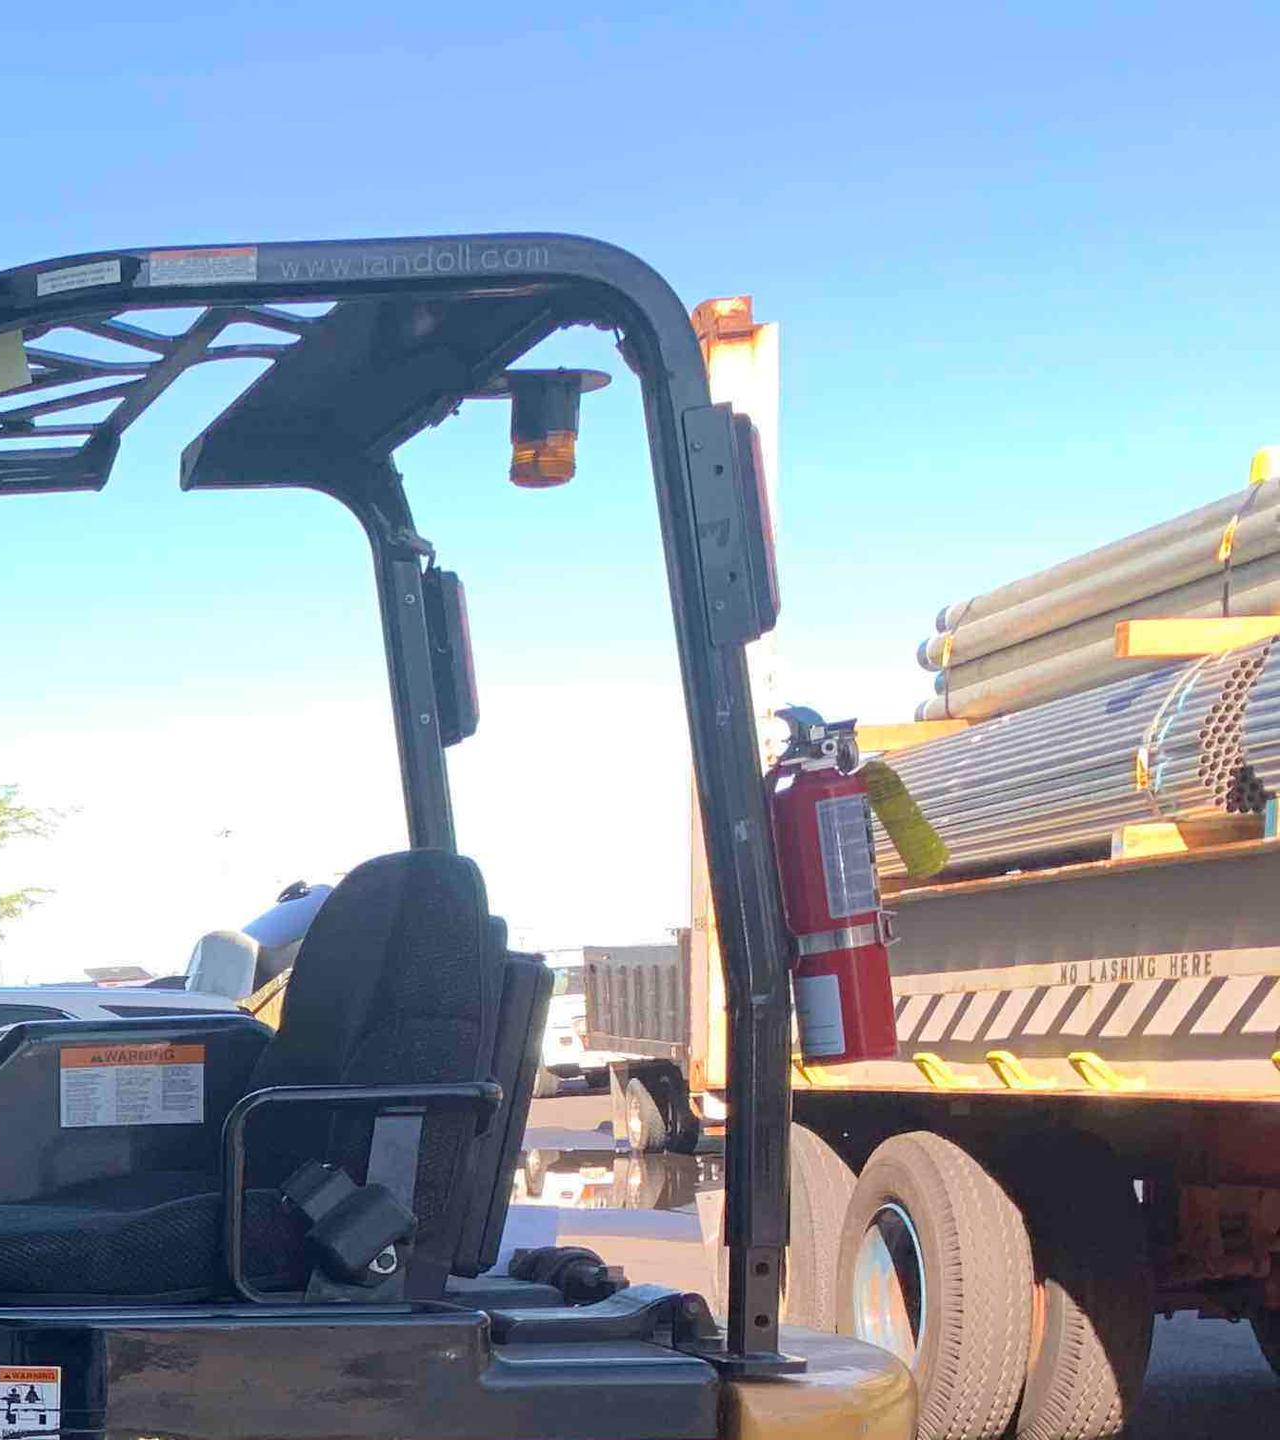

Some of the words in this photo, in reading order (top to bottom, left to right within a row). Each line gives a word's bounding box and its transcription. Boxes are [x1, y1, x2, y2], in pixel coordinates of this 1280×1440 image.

[280, 243, 549, 279] www.landoll.com
[1060, 963, 1078, 984] NO
[1090, 957, 1157, 982] LASHING
[1170, 953, 1213, 976] HERE
[105, 1049, 175, 1062] WARNING
[11, 1370, 56, 1380] WARNING
